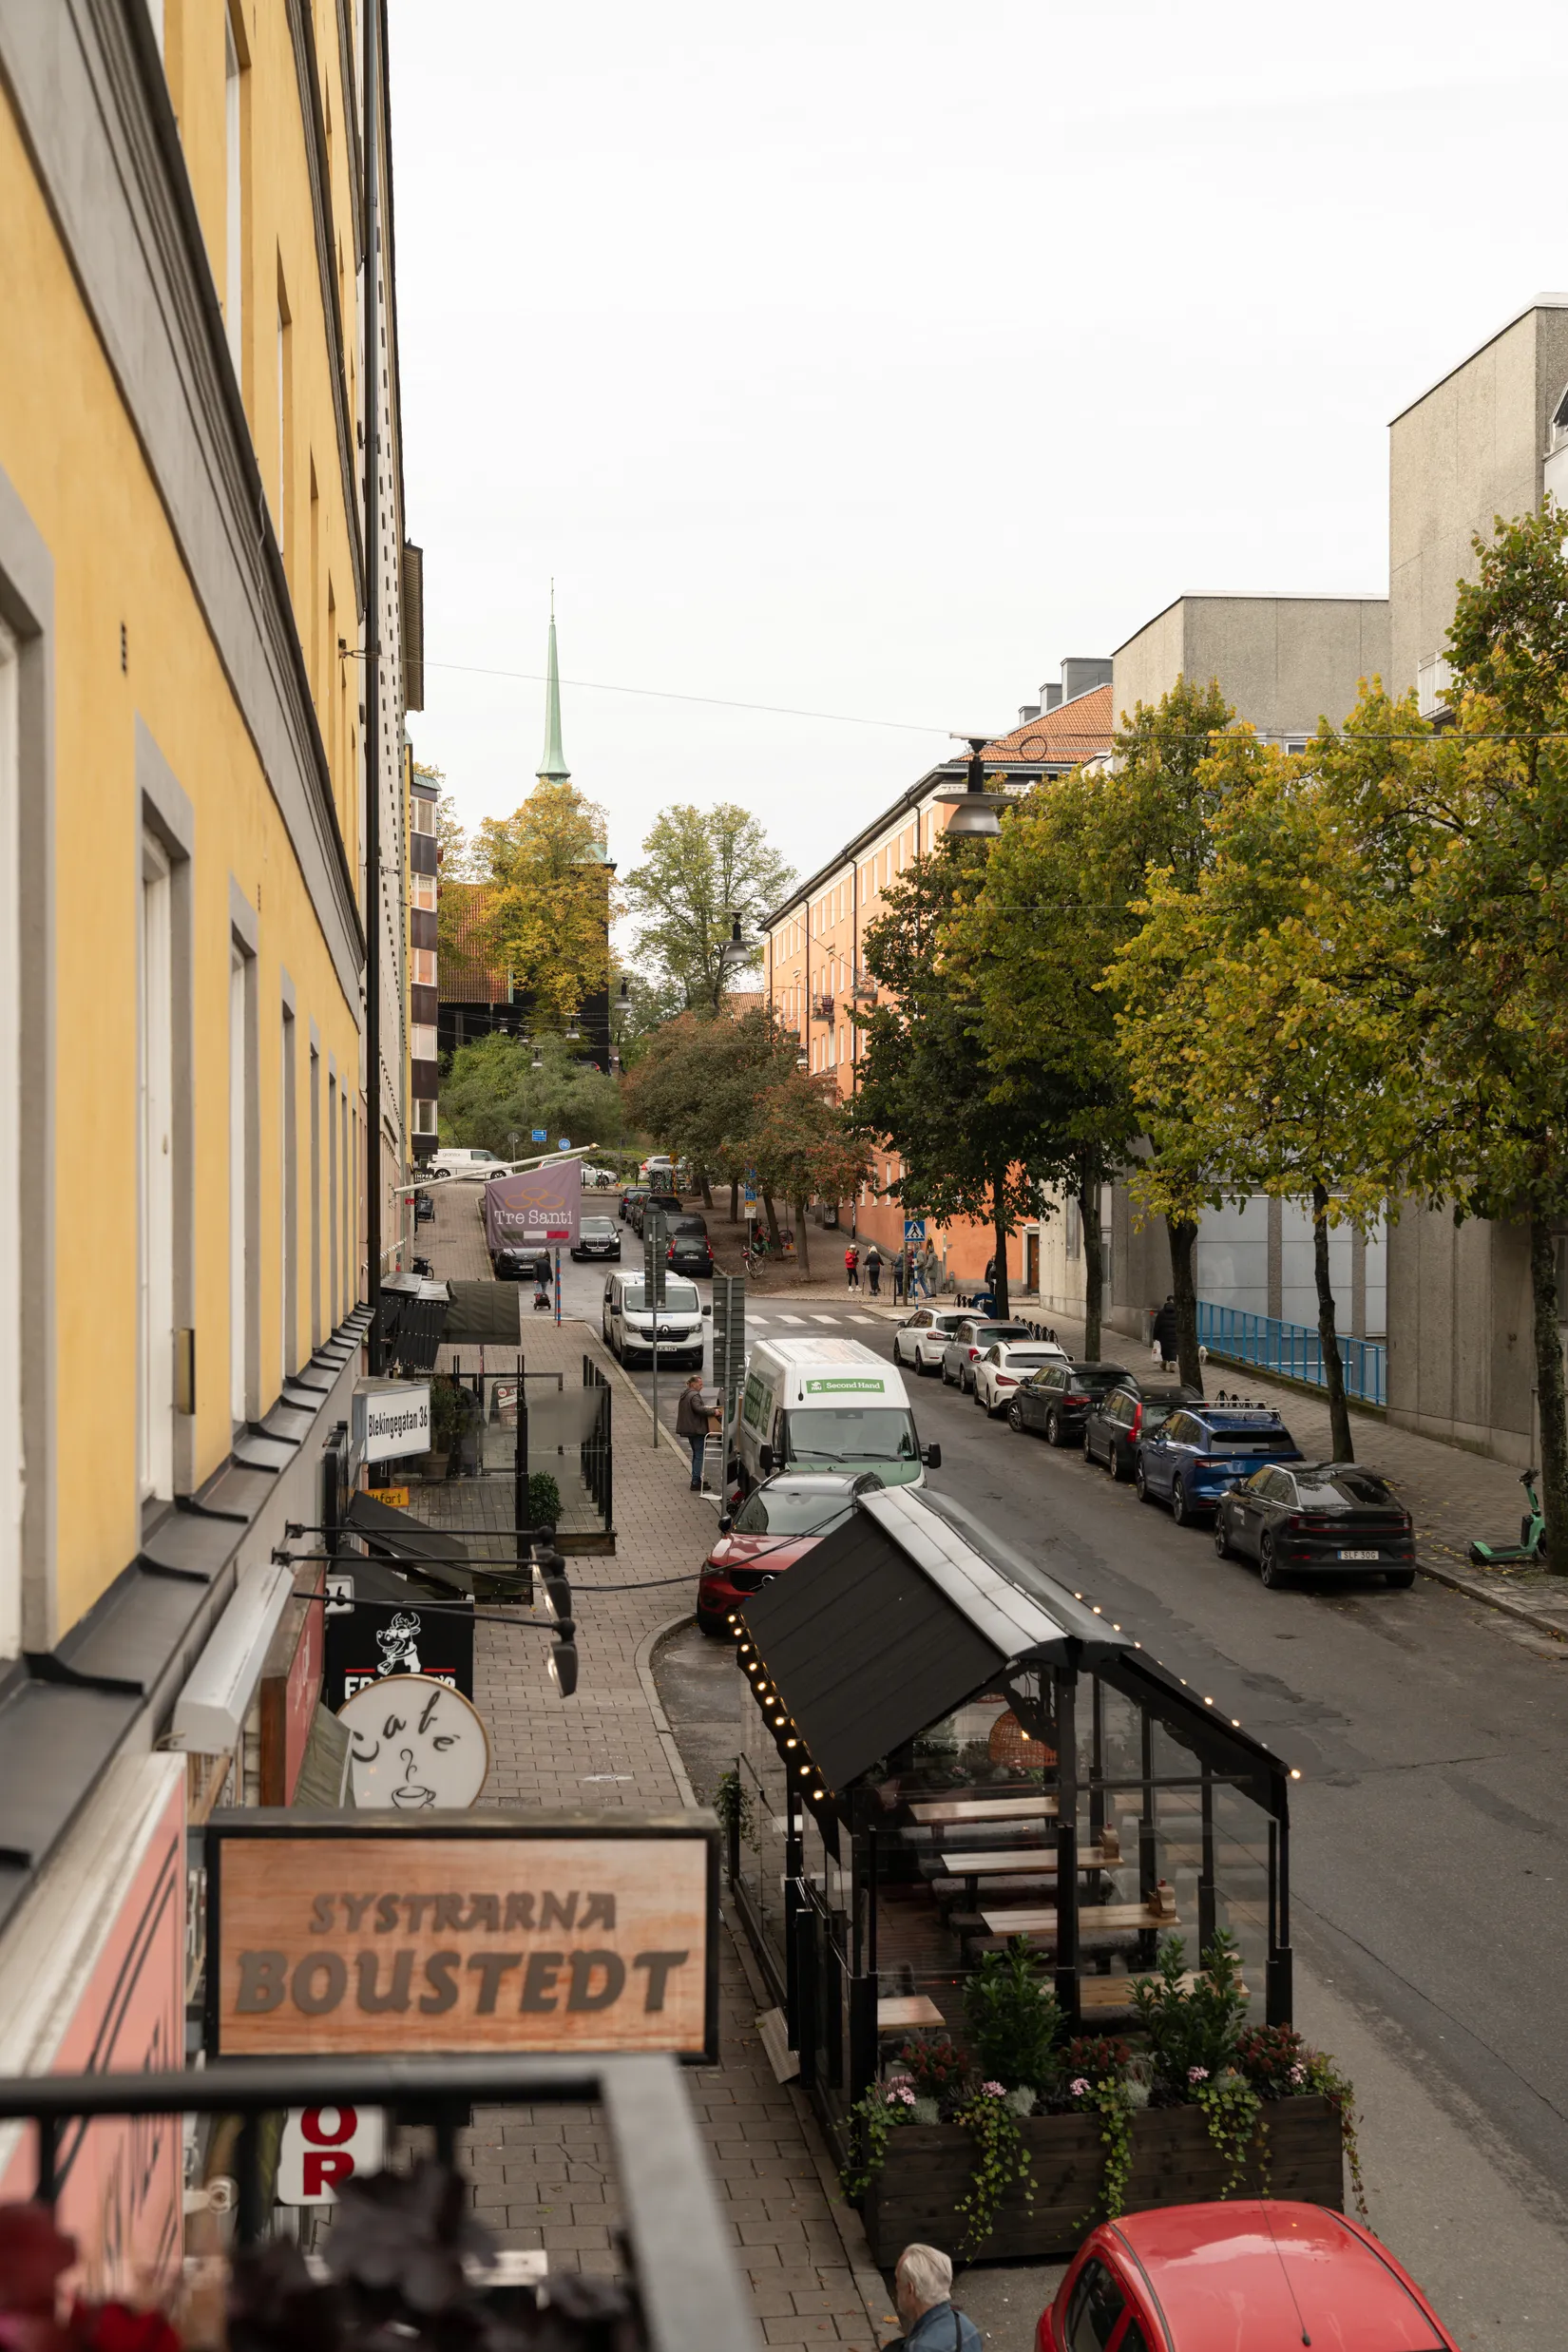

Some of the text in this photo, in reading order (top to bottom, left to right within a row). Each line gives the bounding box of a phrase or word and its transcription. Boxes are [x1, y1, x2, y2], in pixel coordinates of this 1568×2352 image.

[494, 1210, 573, 1225] Tre Santi
[369, 1405, 428, 1439] Blekingegatan 36
[308, 1890, 616, 1935] SYSTRARNA
[234, 1948, 690, 2016] BOUSTEDT
